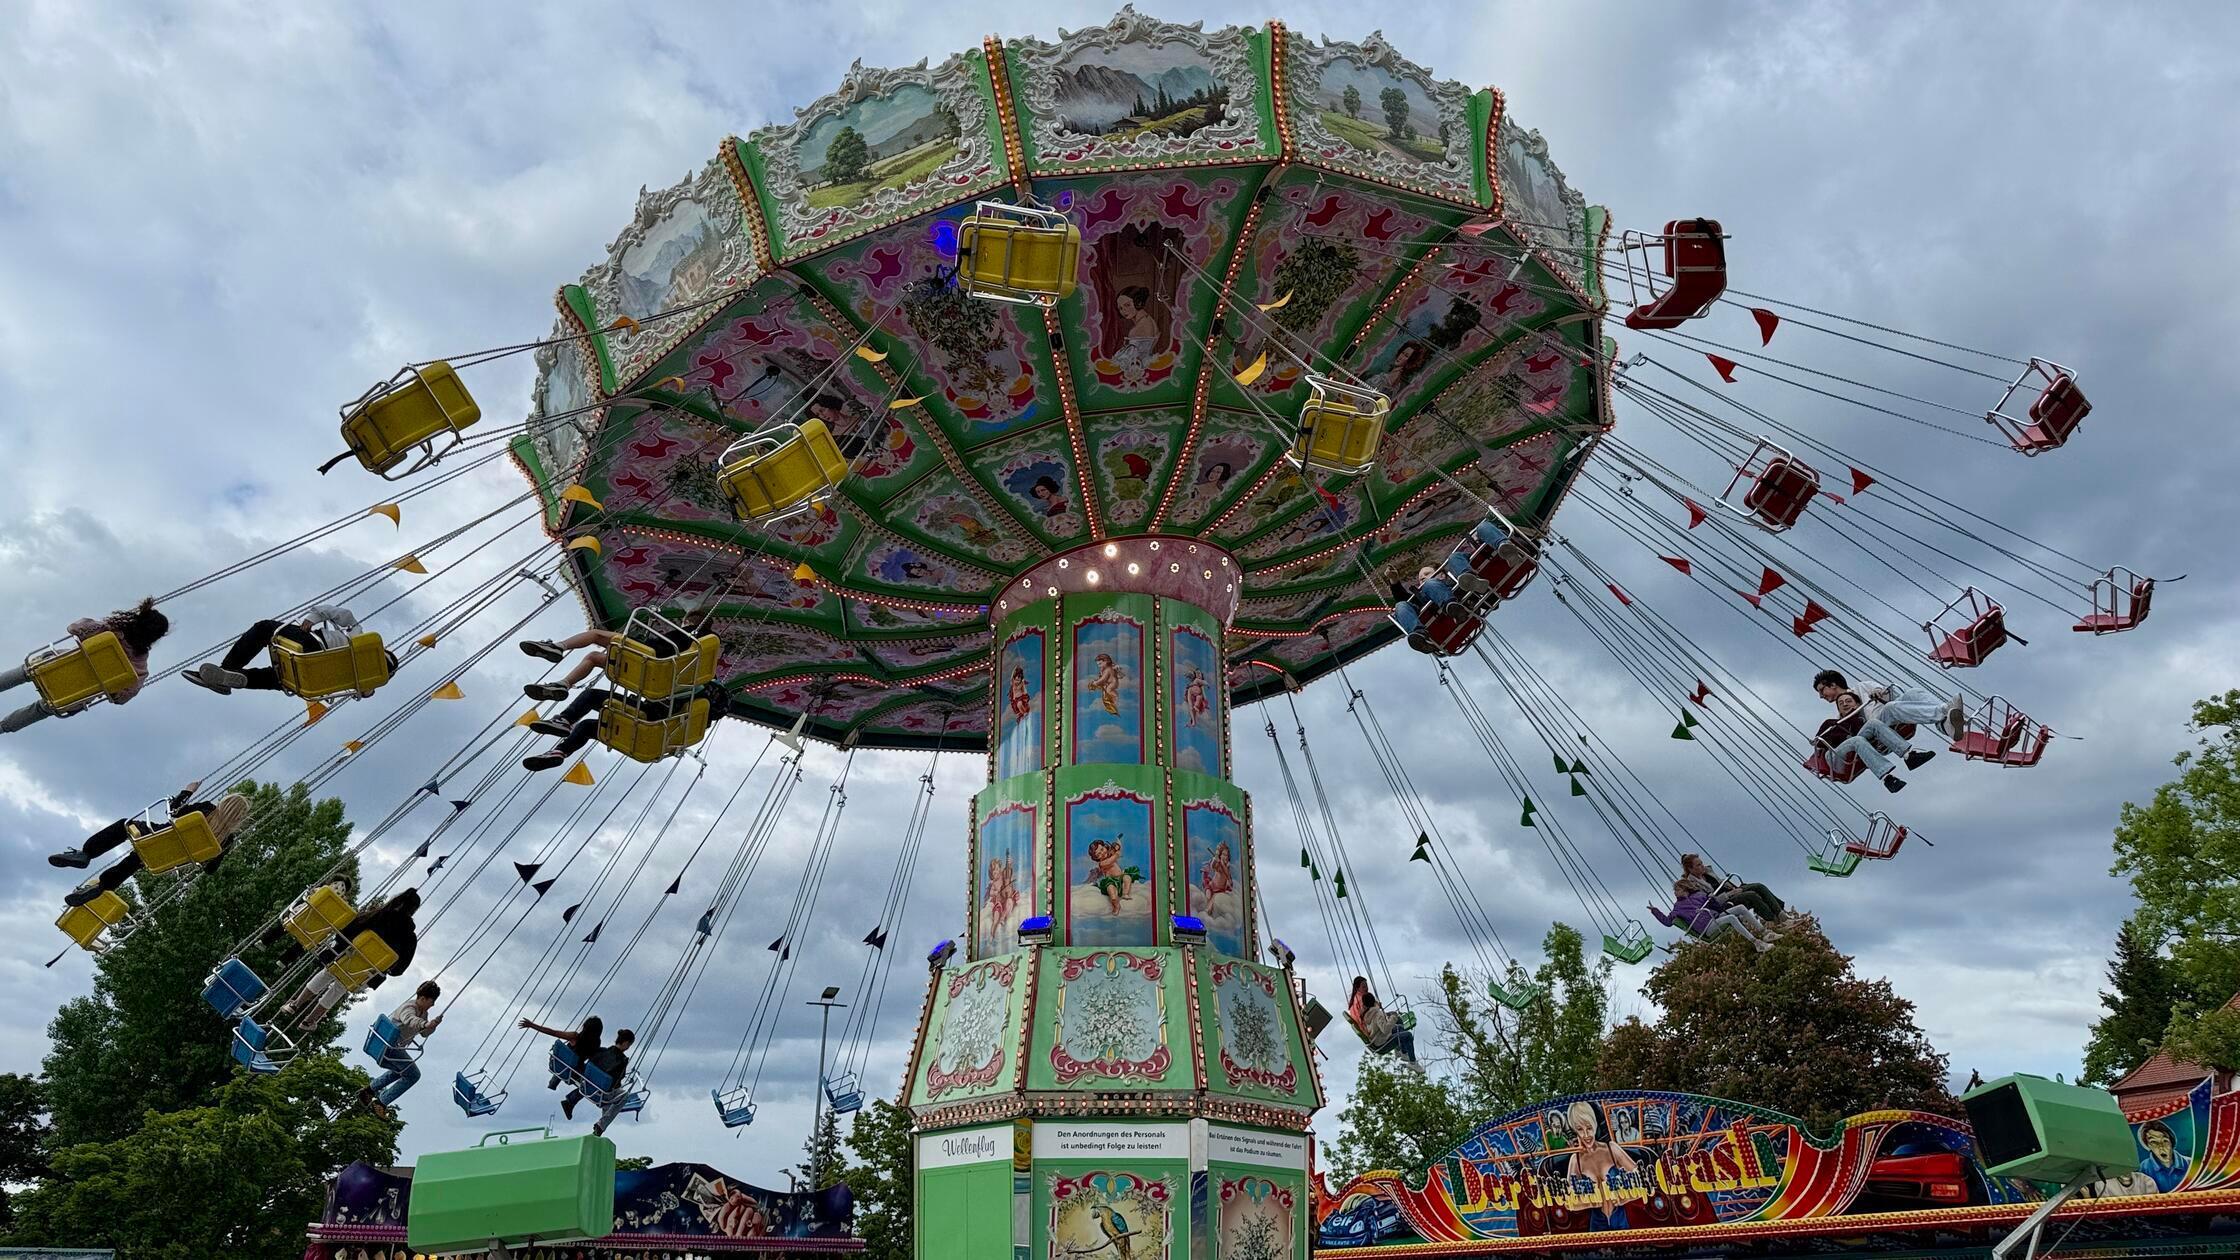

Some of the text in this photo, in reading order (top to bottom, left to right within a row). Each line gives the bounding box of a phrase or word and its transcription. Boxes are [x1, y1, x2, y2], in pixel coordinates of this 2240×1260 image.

[1072, 1131, 1119, 1139] Anordnungen
[1216, 1132, 1234, 1140] Ertönen
[1241, 1136, 1256, 1144] Signals
[942, 1135, 995, 1158] Wellenflug
[1070, 1142, 1105, 1150] unbedingt
[1107, 1142, 1125, 1150] Folge
[1449, 1156, 1520, 1212] Der
[1657, 1118, 1778, 1193] Crash
[1332, 1216, 1354, 1227] elf
